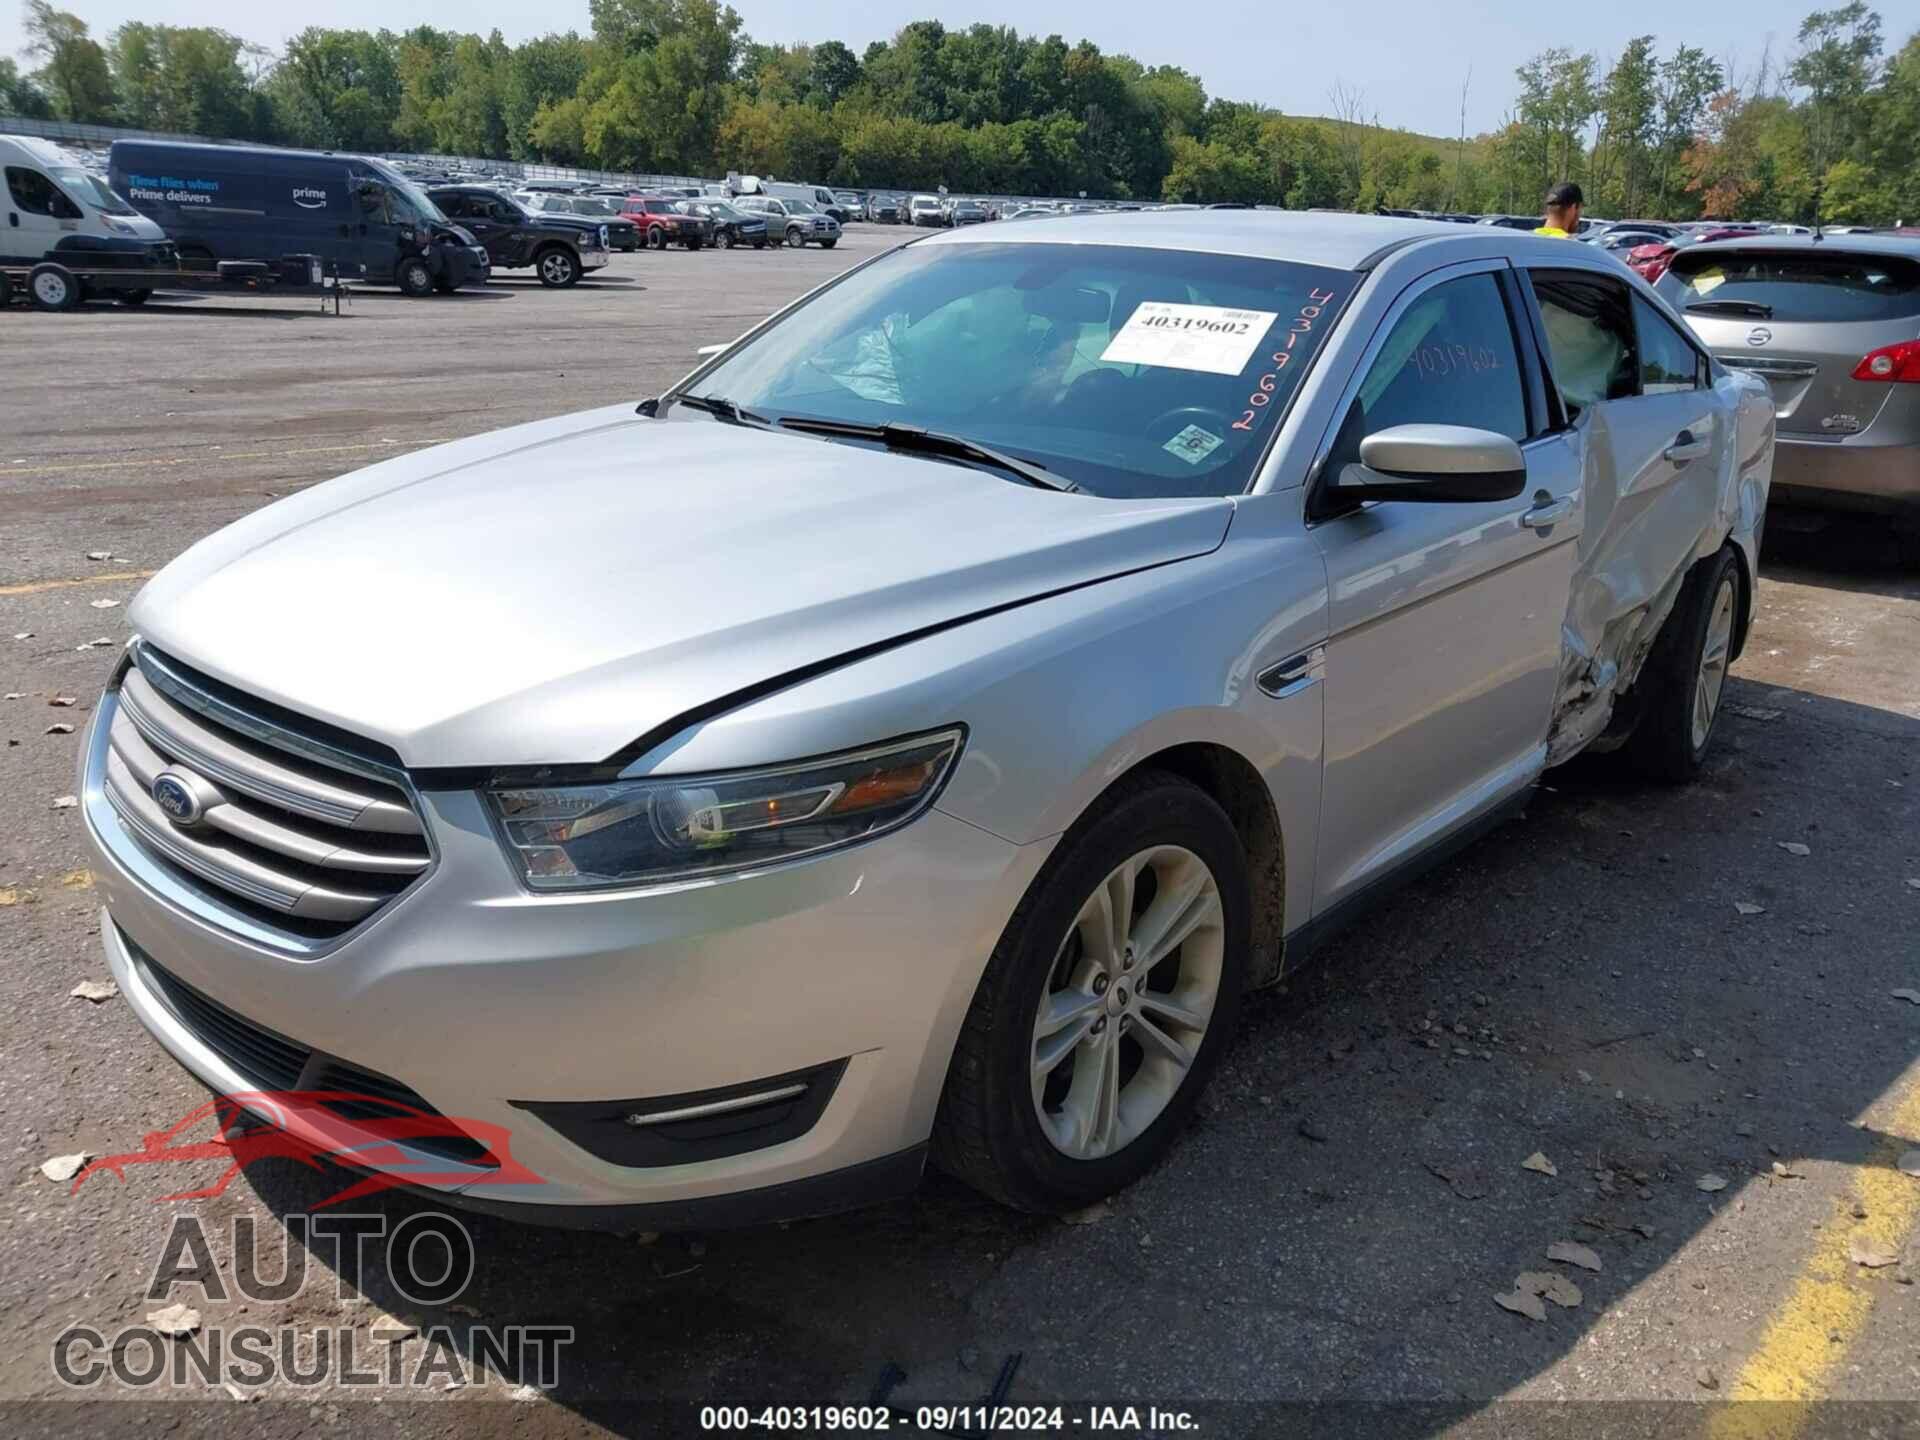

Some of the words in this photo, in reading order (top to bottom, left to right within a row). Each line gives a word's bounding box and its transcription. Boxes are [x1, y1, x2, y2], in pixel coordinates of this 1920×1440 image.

[129, 175, 158, 187] Time
[160, 176, 185, 189] flies
[187, 179, 219, 191] when
[130, 188, 164, 201] Prime
[166, 190, 212, 204] delivers
[292, 187, 327, 201] prime
[1141, 315, 1251, 336] 40319602
[1231, 287, 1335, 432] 40319602
[158, 783, 185, 815] Ford
